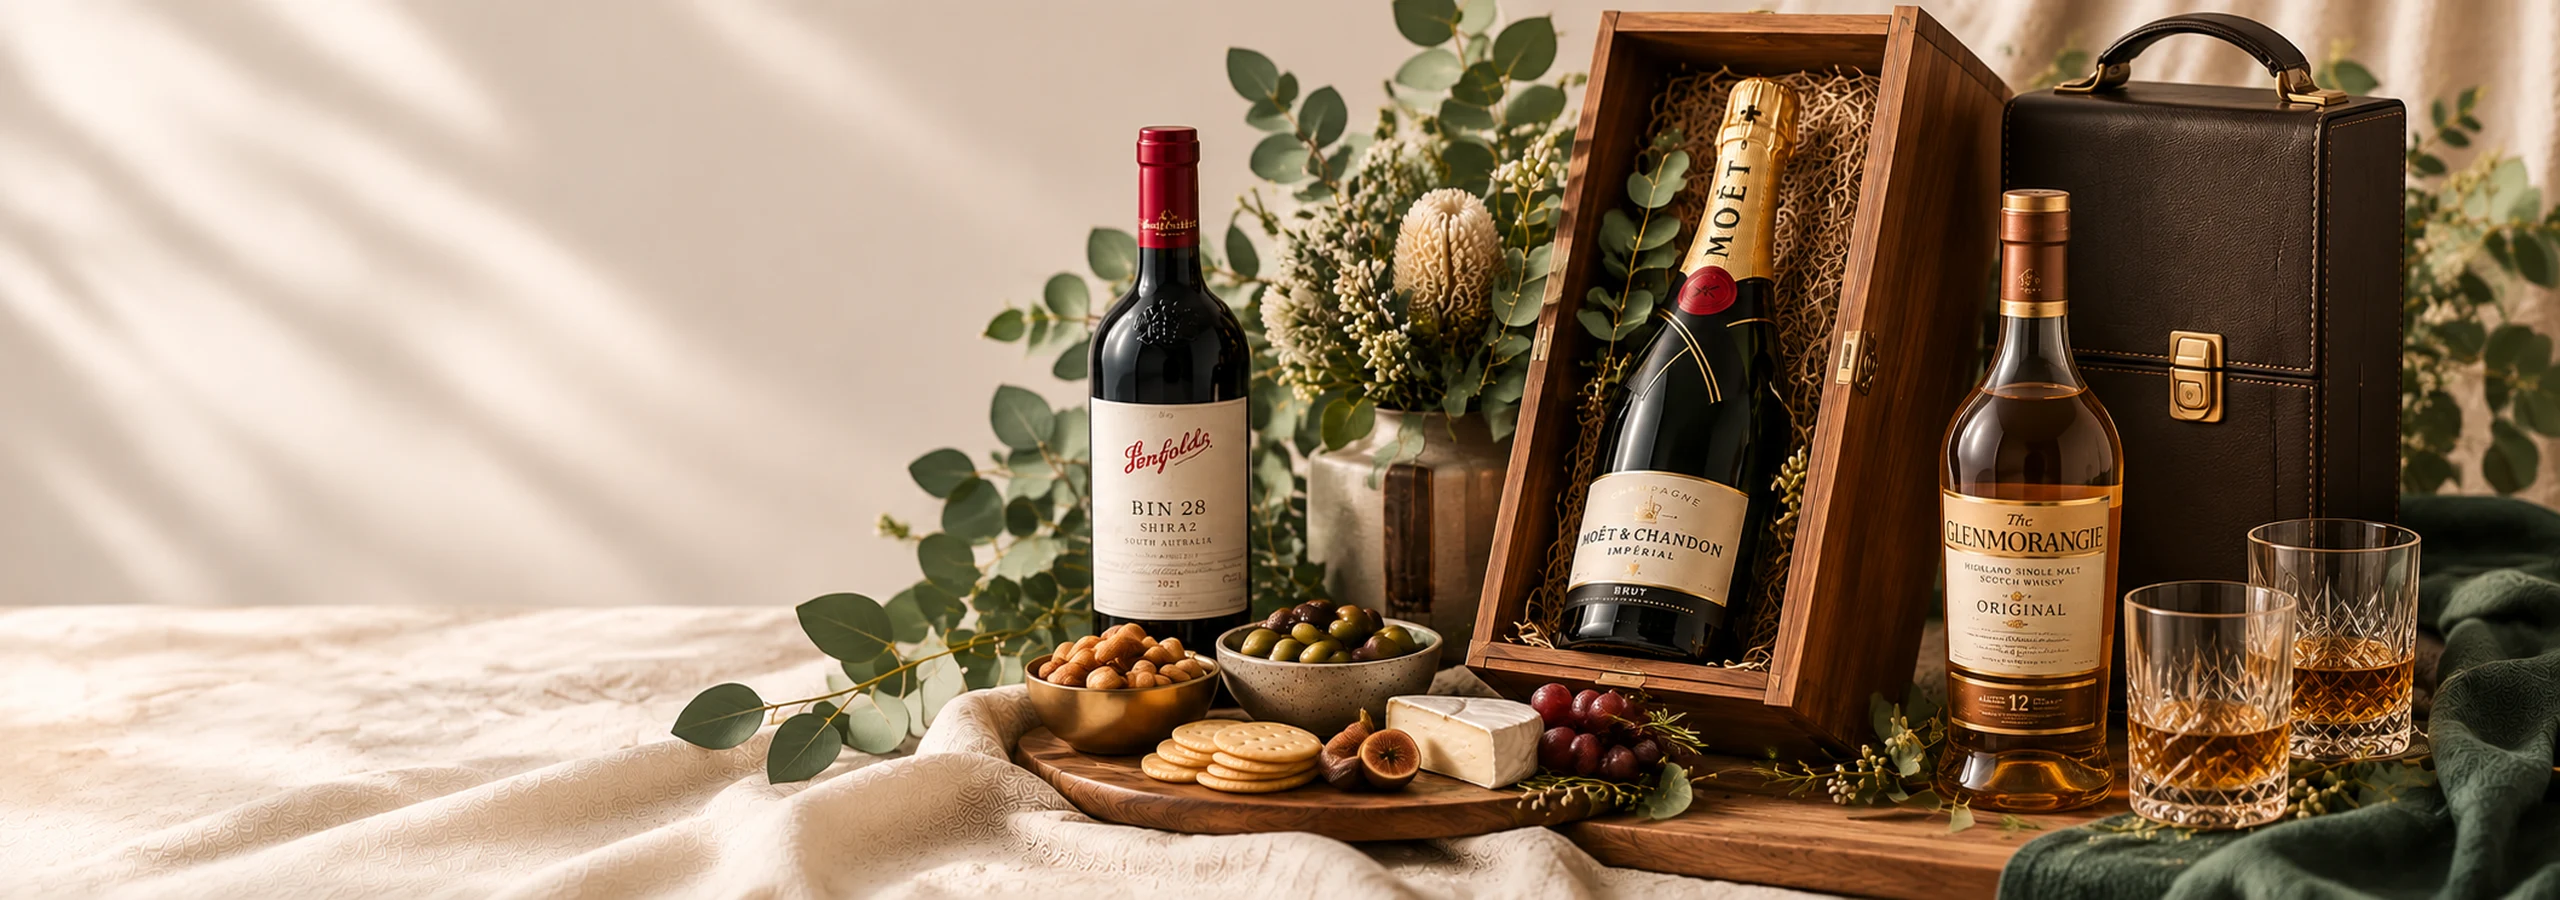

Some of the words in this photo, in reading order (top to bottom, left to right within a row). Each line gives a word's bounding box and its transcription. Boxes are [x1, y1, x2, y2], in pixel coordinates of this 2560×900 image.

[1131, 500, 1172, 516] BIN
[1181, 499, 1206, 516] 28
[1124, 537, 1156, 546] SOUTH
[1619, 527, 1631, 540] &
[1634, 528, 1723, 558] CHANDON
[1946, 520, 2104, 553] GLENMORANGIE
[1613, 586, 1648, 596] BRUT
[1976, 600, 2067, 616] ORIGINAL
[2008, 693, 2029, 712] 12
